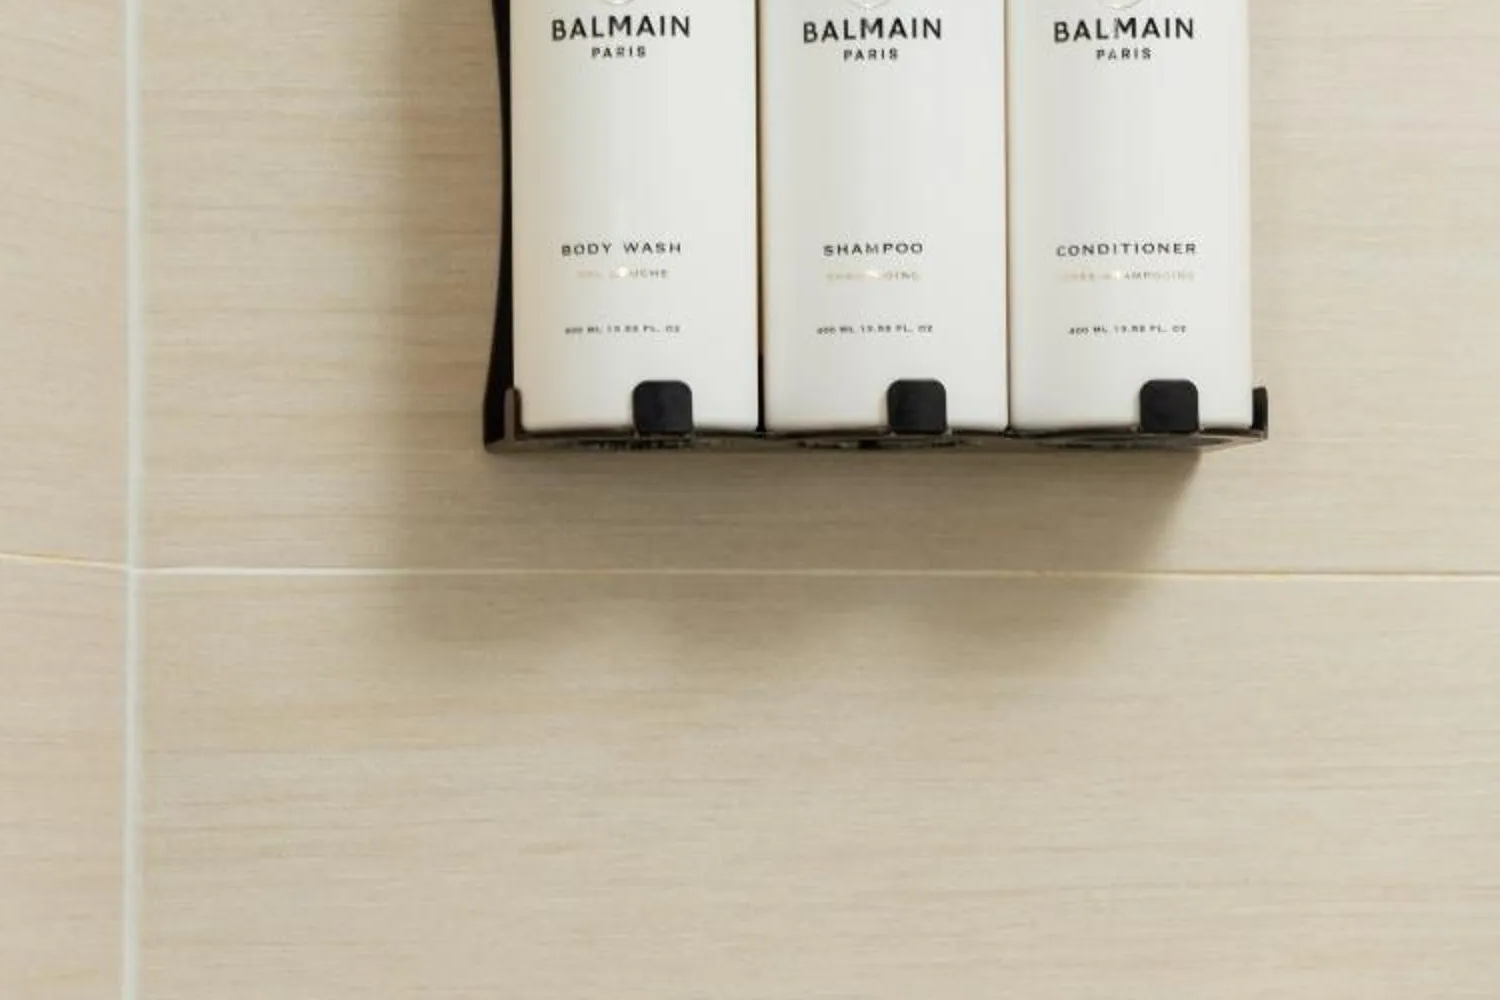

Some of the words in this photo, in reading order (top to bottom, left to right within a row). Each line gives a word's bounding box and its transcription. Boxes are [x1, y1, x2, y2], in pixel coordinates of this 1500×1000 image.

[551, 15, 690, 41] BALMAIN
[803, 17, 942, 43] BALMAIN
[1053, 17, 1194, 43] BALMAIN
[591, 46, 646, 59] PARIS
[843, 48, 898, 61] PARIS
[1096, 48, 1152, 60] PARIS
[561, 242, 612, 257] BODY
[623, 241, 682, 255] WASH
[822, 242, 923, 257] SHAMPOO
[1055, 242, 1197, 257] CONDITIONER
